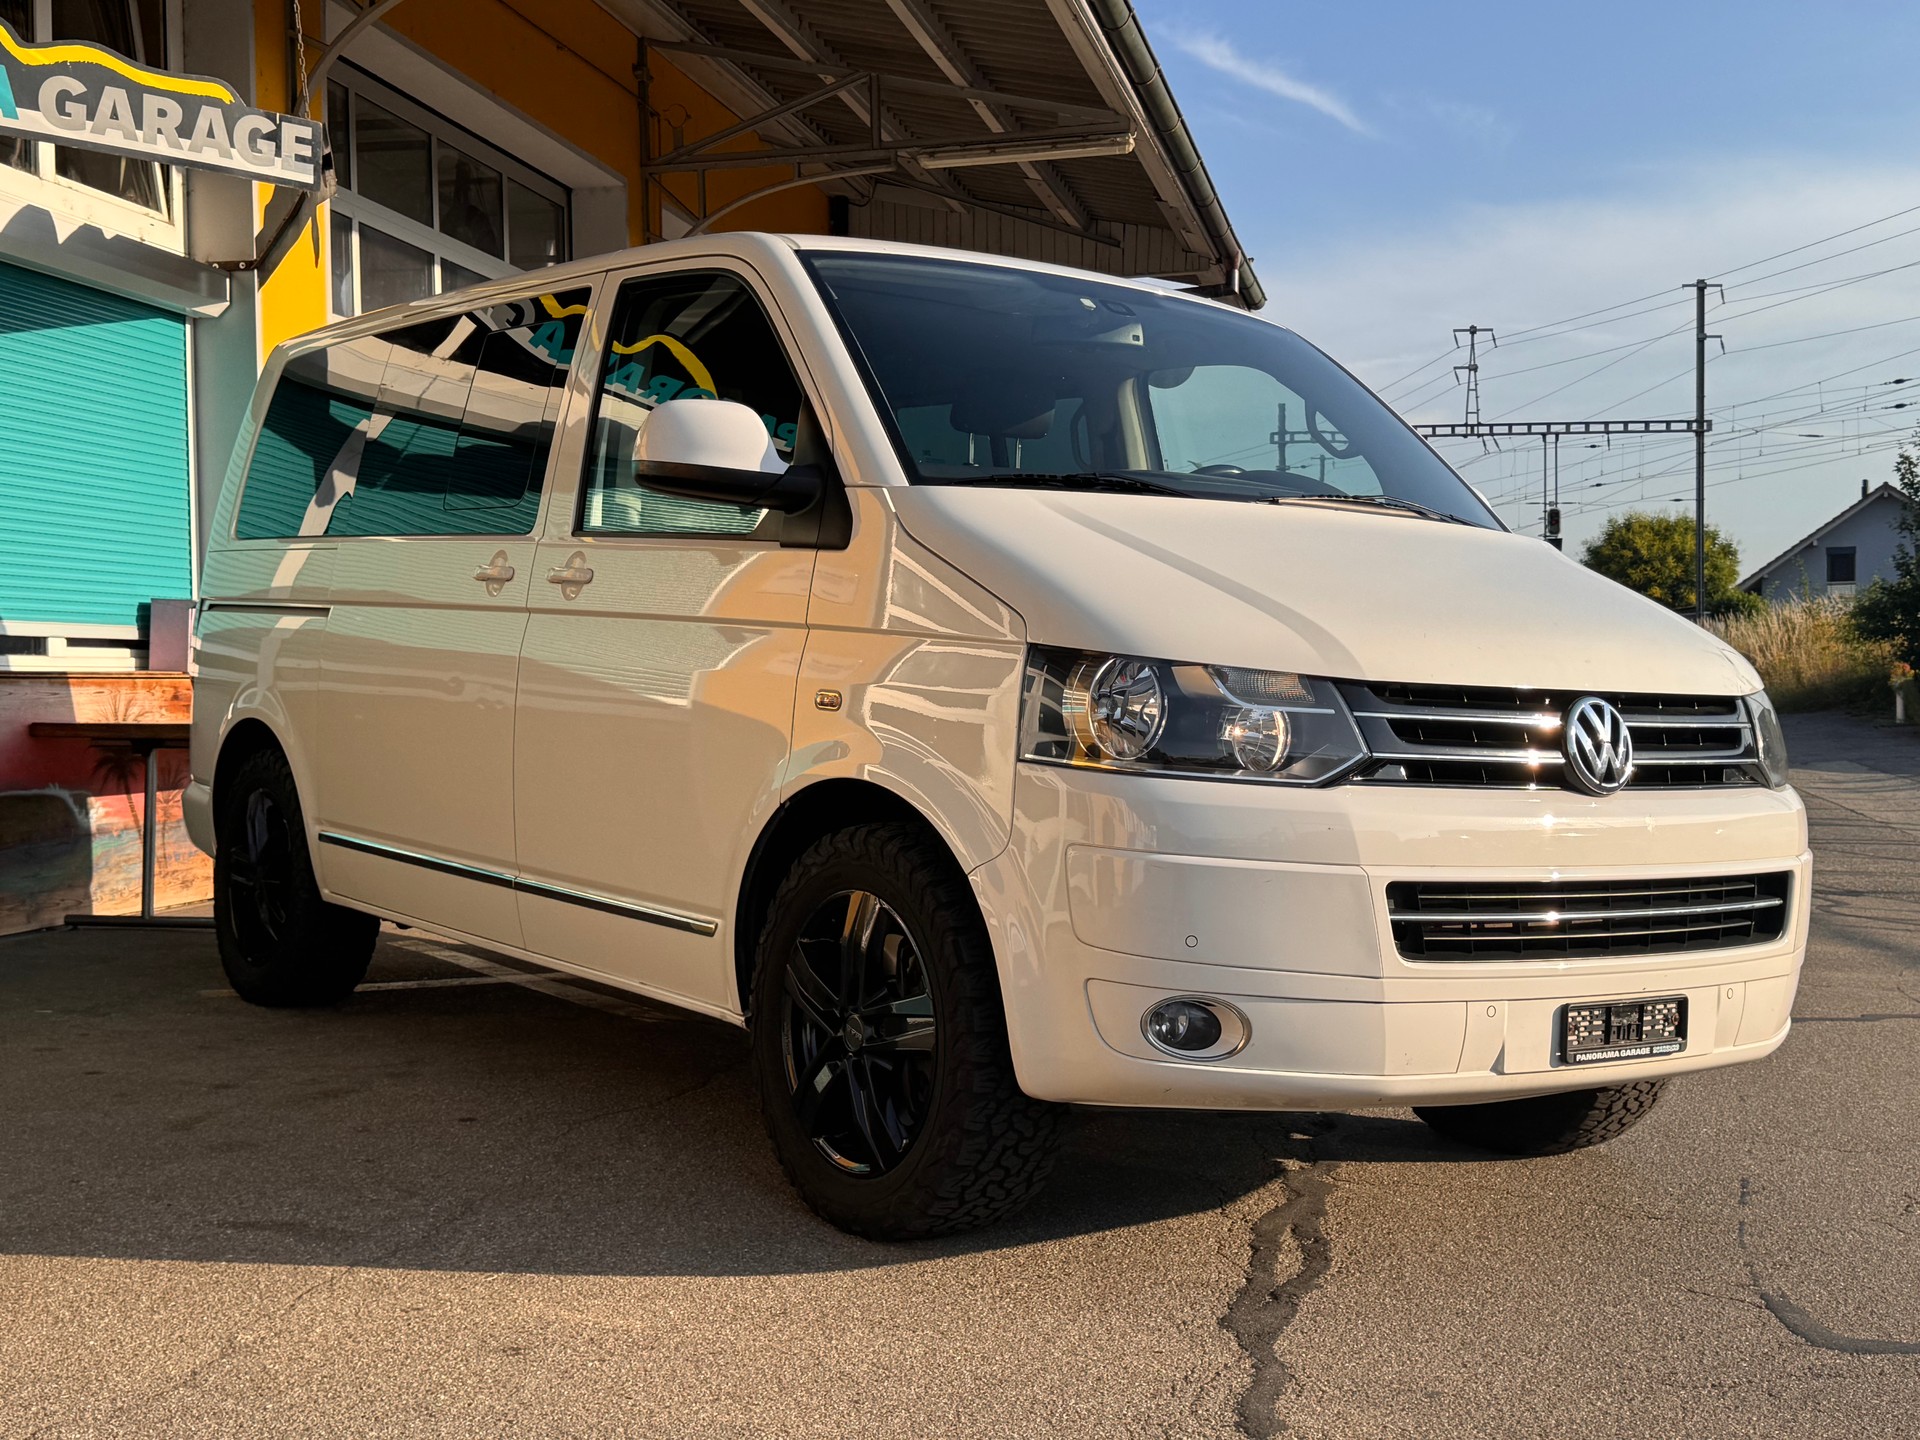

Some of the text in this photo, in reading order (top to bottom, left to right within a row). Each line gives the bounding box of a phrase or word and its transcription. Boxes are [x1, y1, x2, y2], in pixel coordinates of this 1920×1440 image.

[38, 75, 315, 174] GARAGE
[1567, 697, 1632, 794] VW
[1576, 1050, 1620, 1062] PANORAMA
[1620, 1047, 1651, 1058] GARAGE
